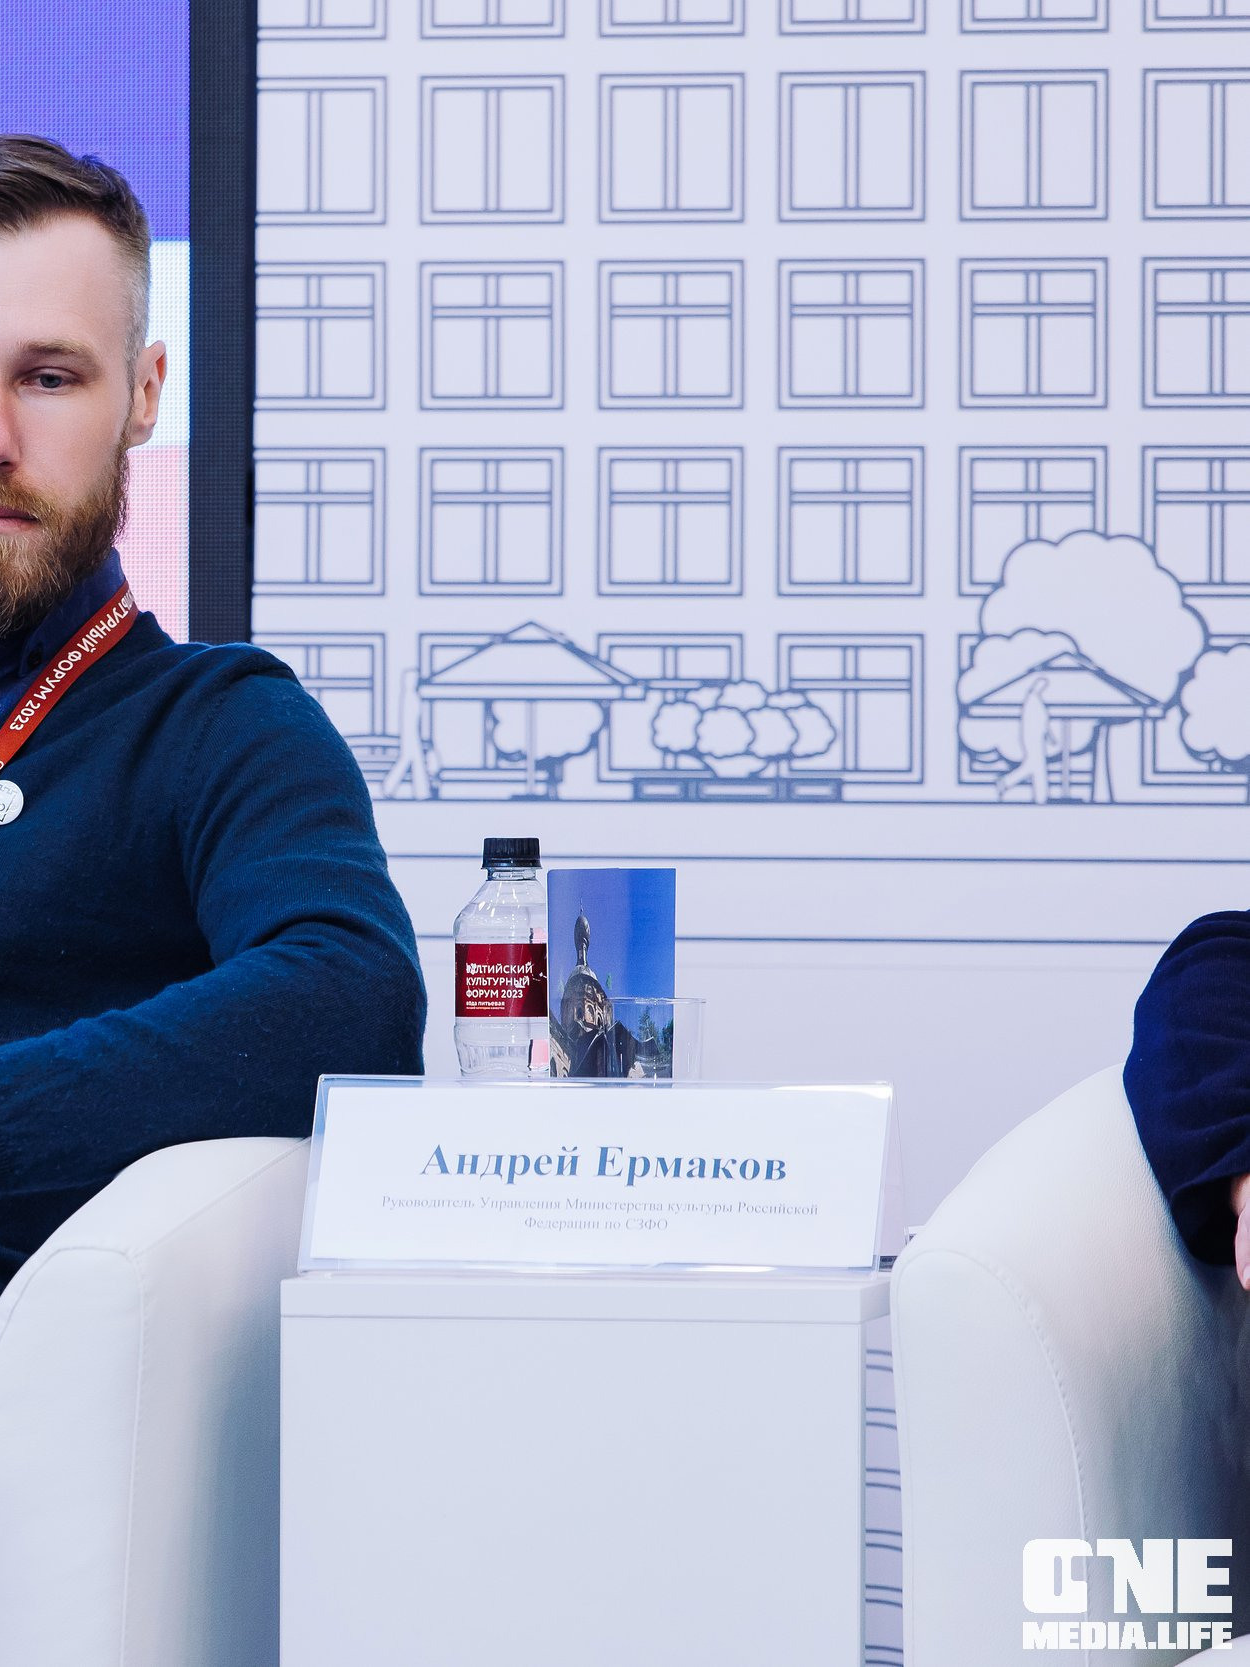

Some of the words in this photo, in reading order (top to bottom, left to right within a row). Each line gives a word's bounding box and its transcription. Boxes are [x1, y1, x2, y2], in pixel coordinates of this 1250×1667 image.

[34, 650, 82, 700] ФОРУМ
[10, 699, 41, 731] 2023
[466, 976, 530, 987] КУЛЬТУРНЫЙ
[466, 989, 499, 998] ФОРУМ
[501, 989, 523, 998] 2023
[419, 1144, 581, 1185] Андрей
[595, 1145, 787, 1188] Ермаков
[382, 1195, 475, 1211] Руководитель
[480, 1196, 561, 1211] Управления
[565, 1198, 663, 1213] Министерства
[667, 1201, 733, 1215] культуры
[738, 1201, 819, 1216] Российской
[524, 1216, 600, 1231] Федерации
[604, 1220, 621, 1231] по
[625, 1217, 668, 1231] СЗФО
